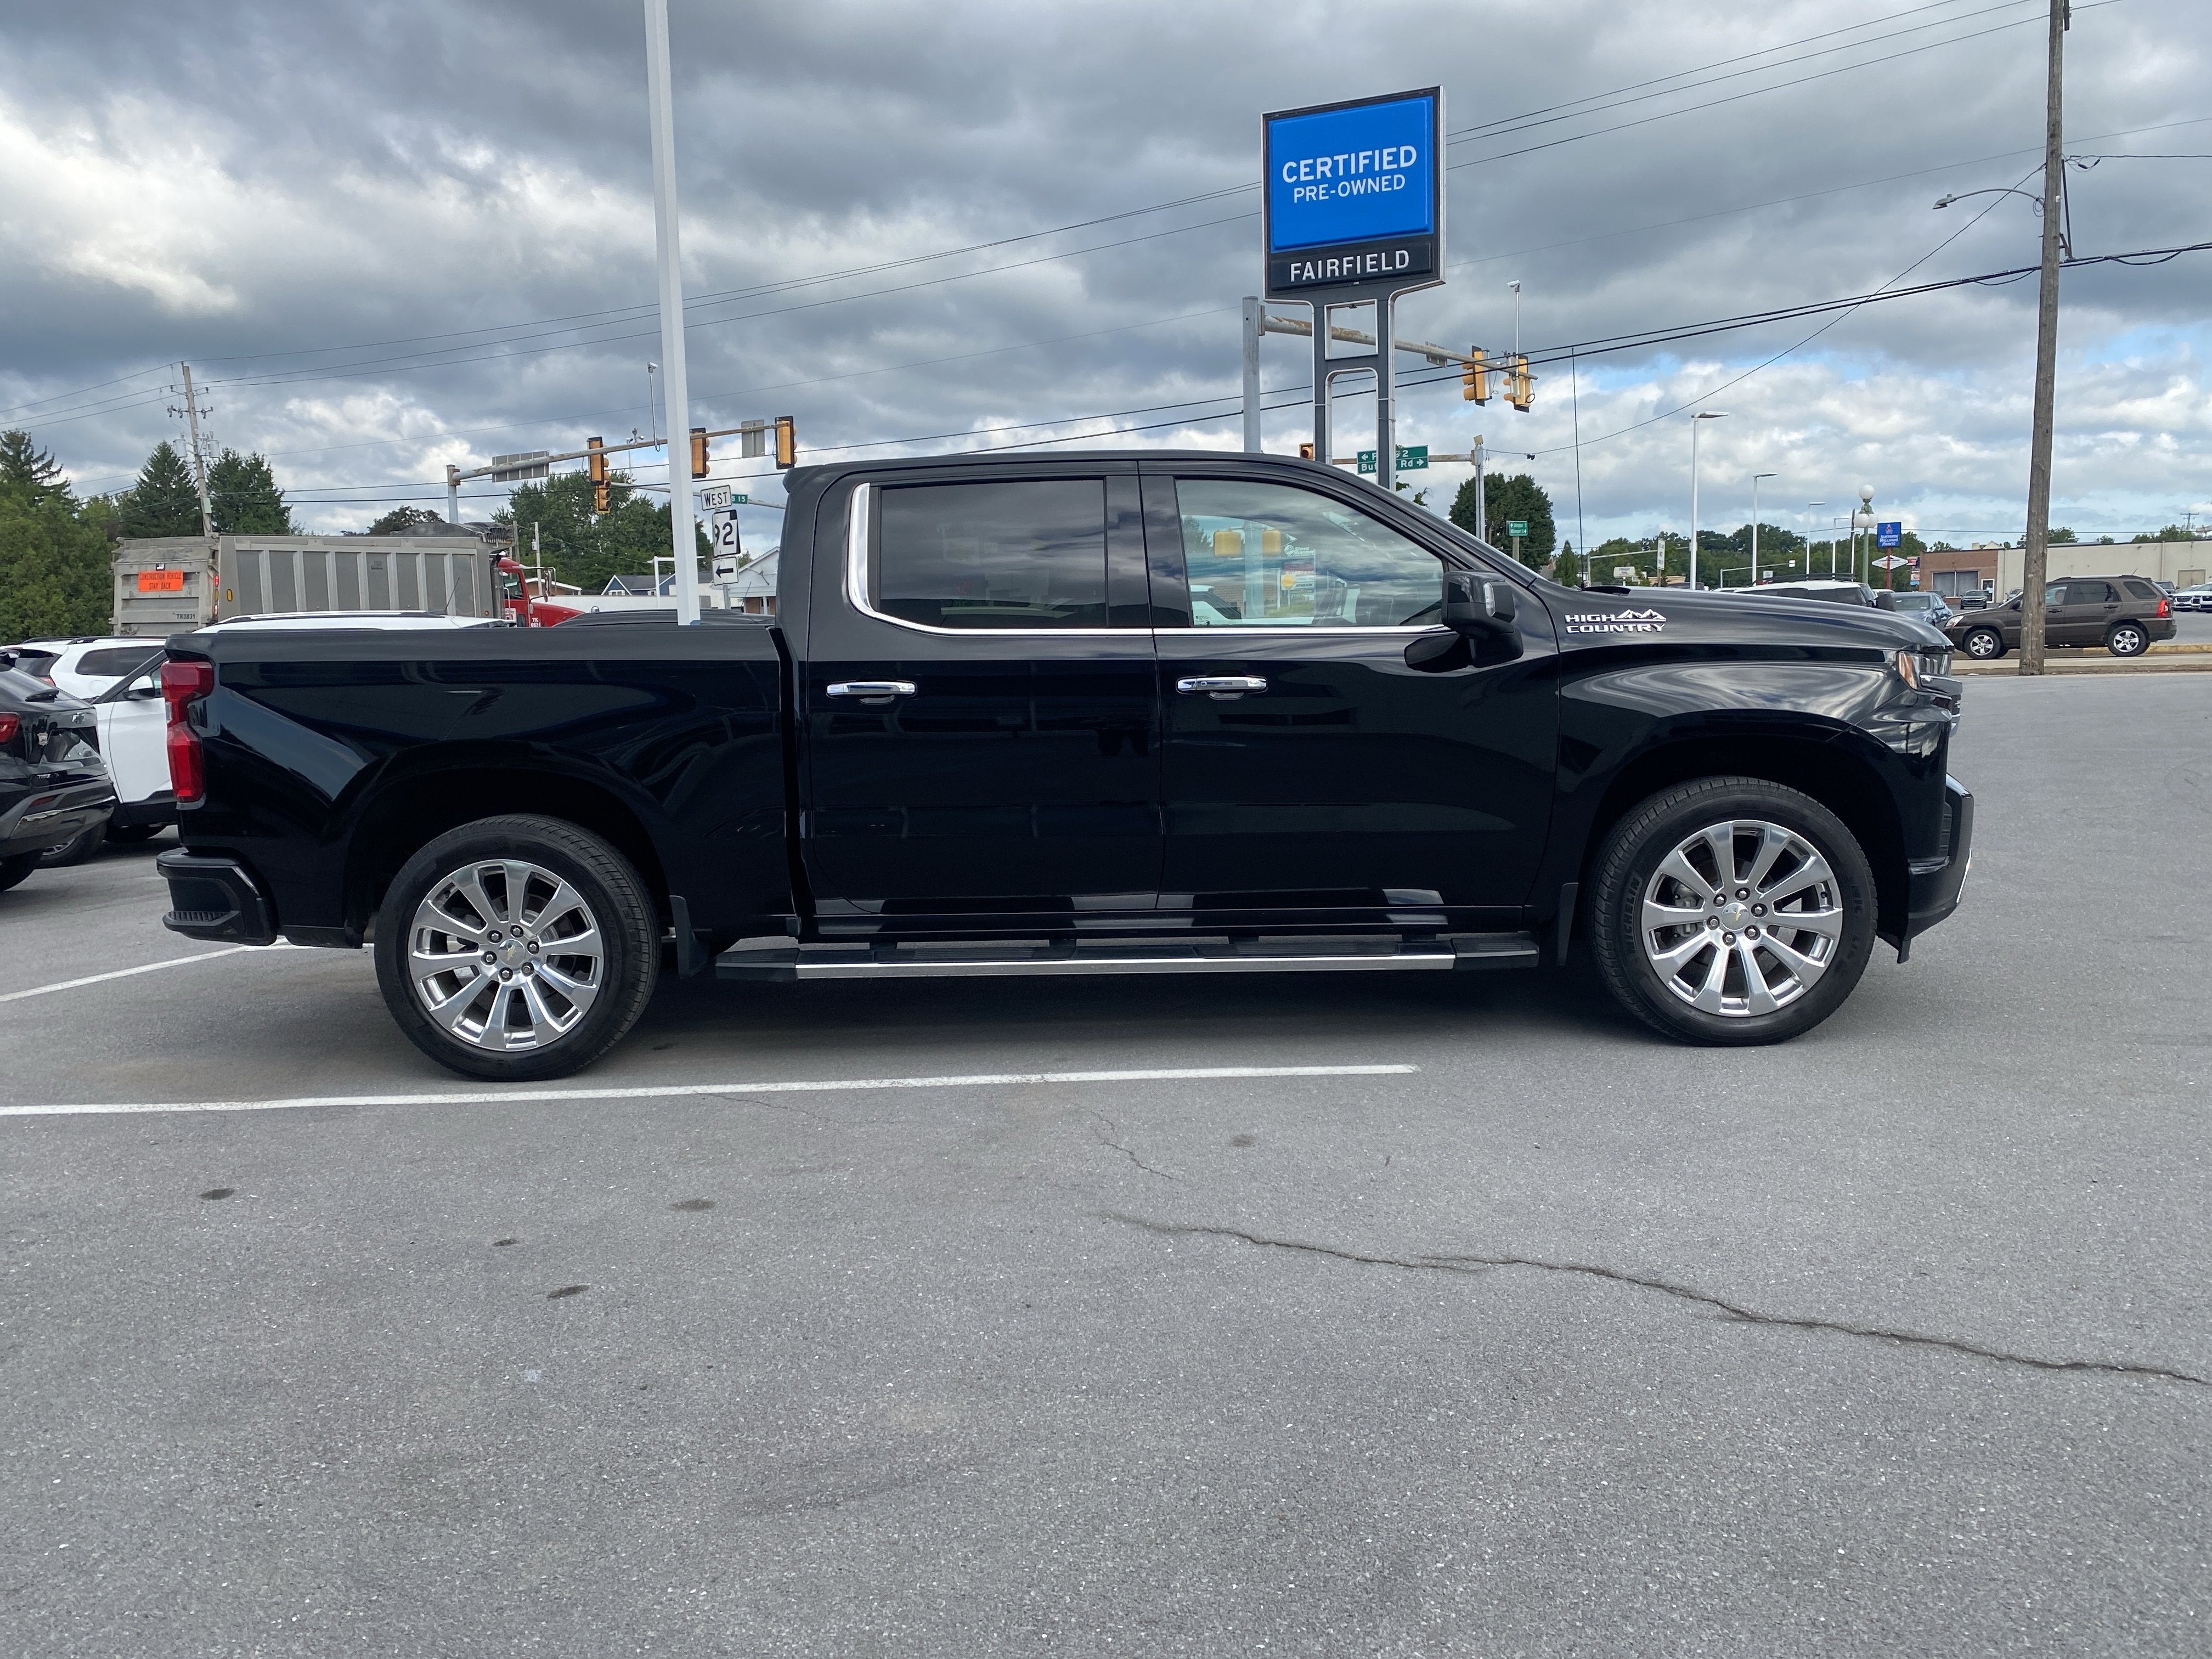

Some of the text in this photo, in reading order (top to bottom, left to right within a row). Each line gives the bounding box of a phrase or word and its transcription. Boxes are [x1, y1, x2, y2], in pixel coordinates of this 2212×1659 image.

[1282, 145, 1417, 183] CERTIFIED
[1294, 174, 1406, 204] PRE-OWNED
[1290, 250, 1410, 283] FAIRFIELD
[1401, 459, 1413, 468] Rd
[704, 492, 727, 507] WEST
[167, 572, 182, 580] VEHICLE
[1565, 614, 1616, 623] HIGH
[1566, 624, 1666, 634] COUNTRY
[1623, 877, 1640, 955] MICHELIN
